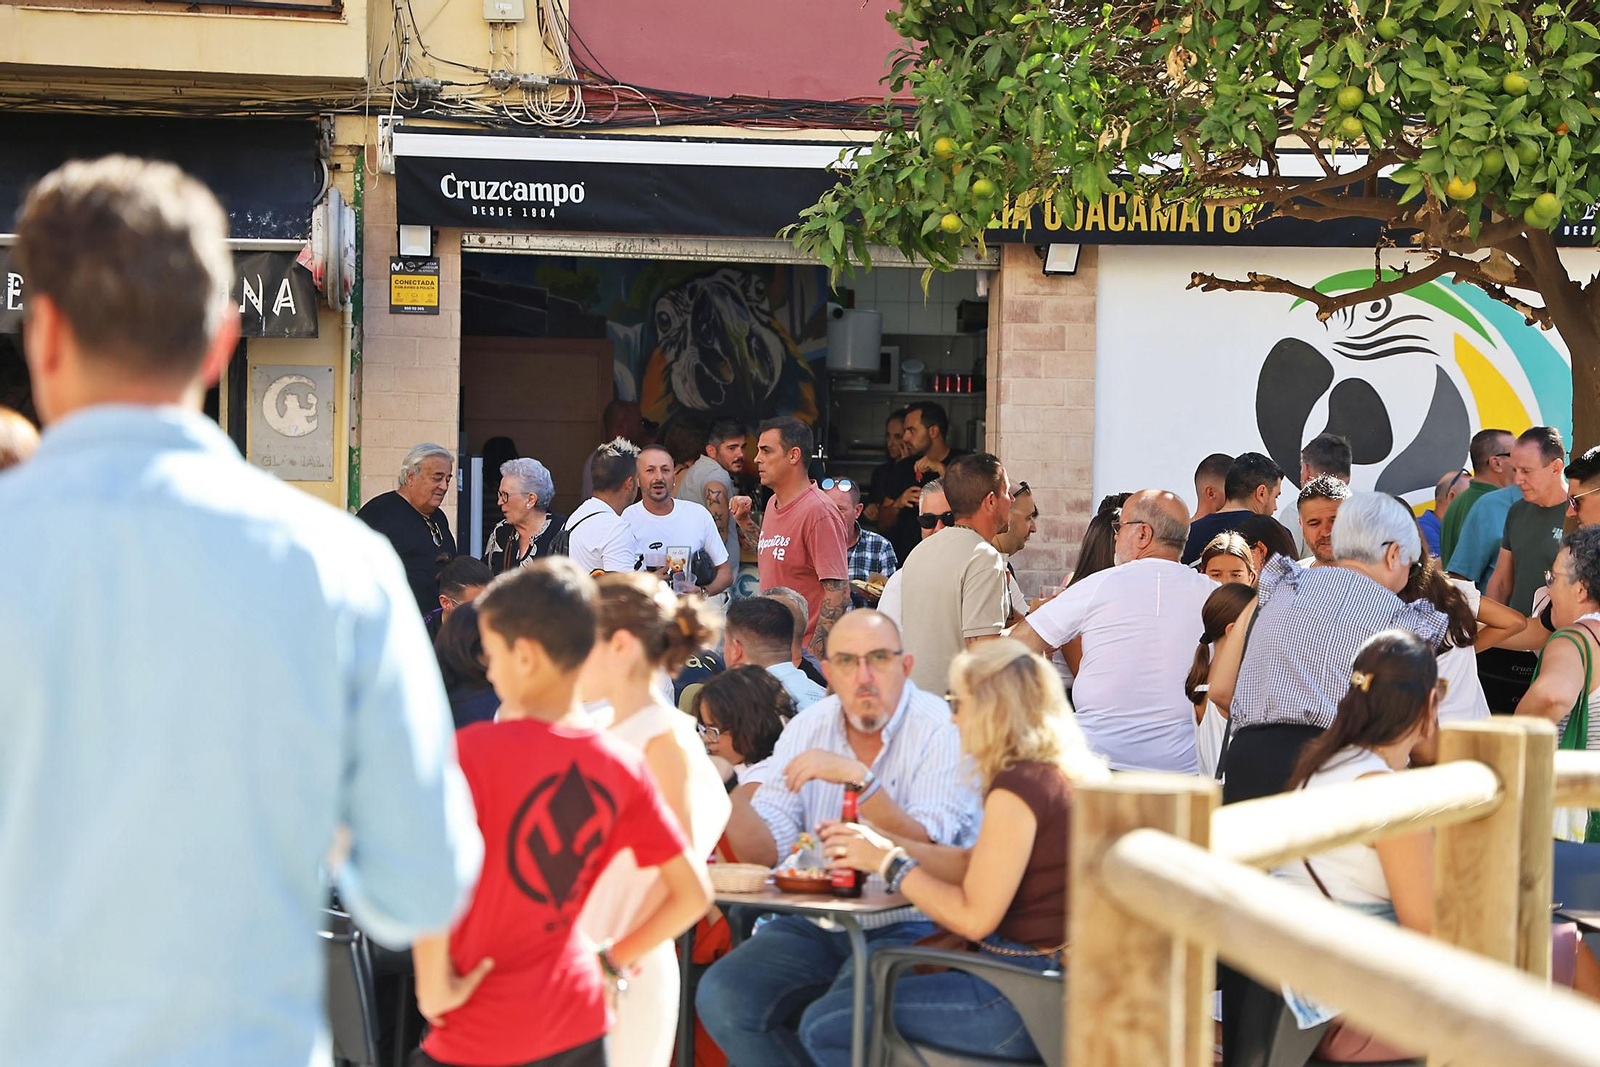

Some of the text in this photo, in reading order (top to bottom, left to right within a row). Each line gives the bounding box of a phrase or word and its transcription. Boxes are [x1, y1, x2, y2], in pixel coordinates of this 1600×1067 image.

[440, 172, 585, 207] Cruzcampo
[472, 205, 556, 218] DESDE 1904
[1564, 225, 1597, 236] DESD
[772, 547, 786, 561] 42
